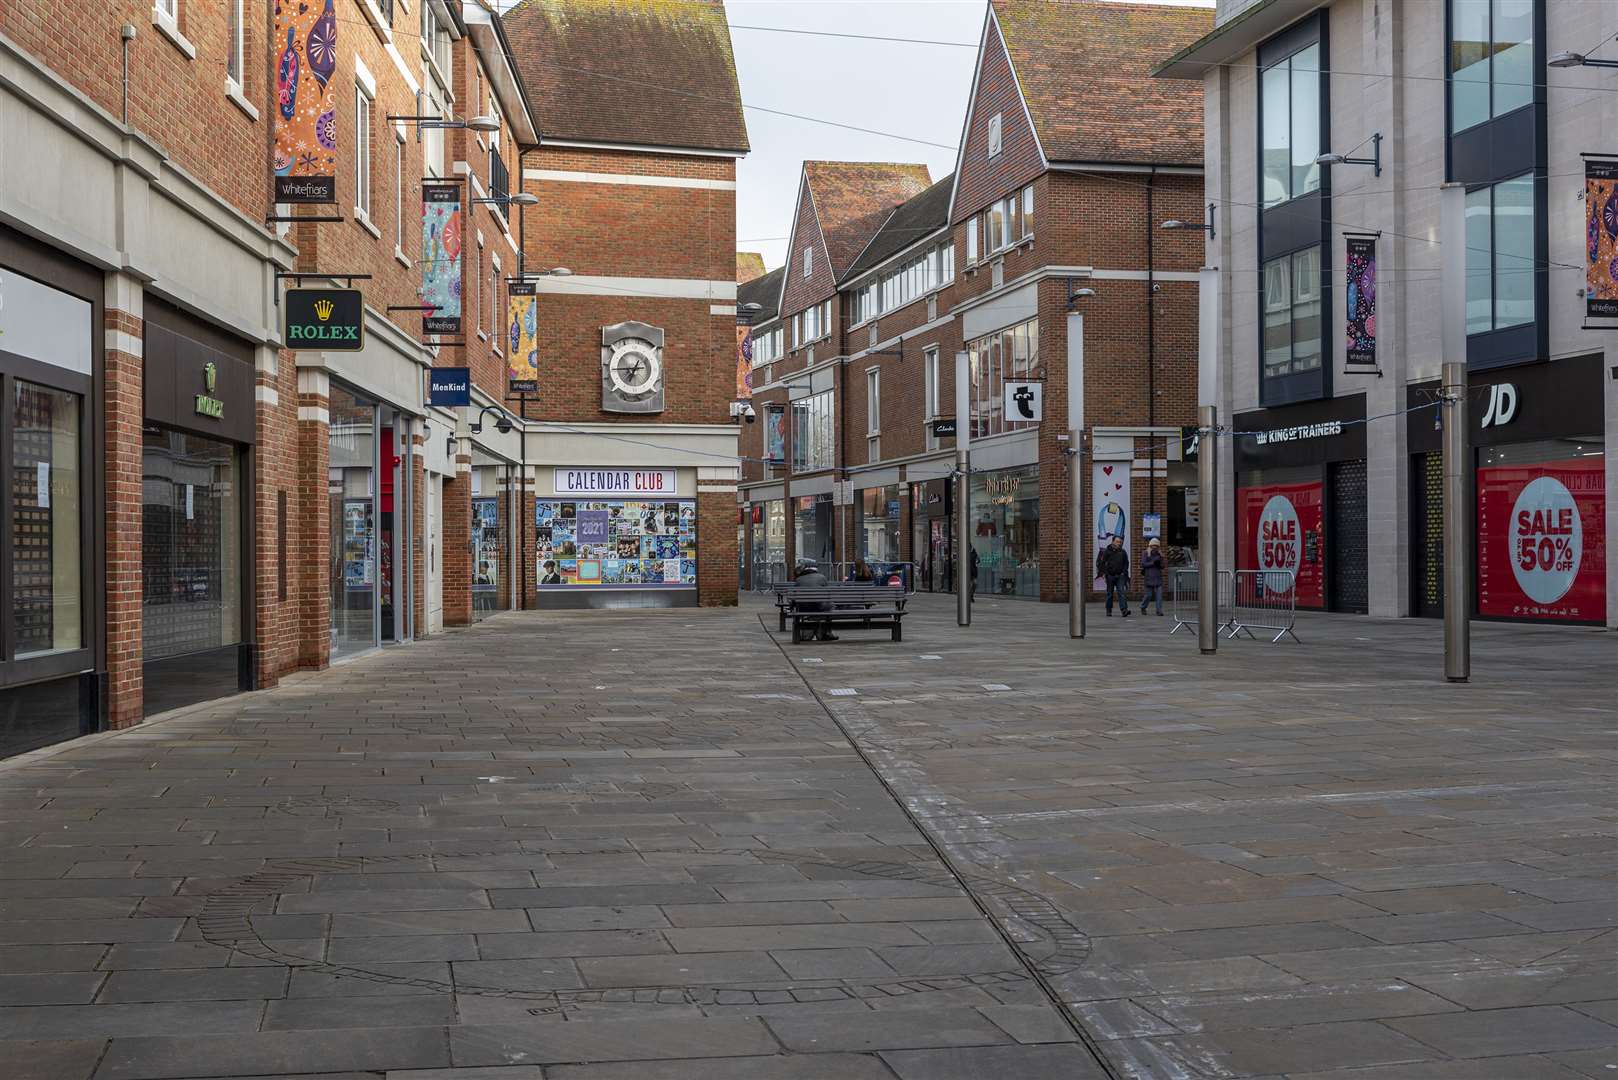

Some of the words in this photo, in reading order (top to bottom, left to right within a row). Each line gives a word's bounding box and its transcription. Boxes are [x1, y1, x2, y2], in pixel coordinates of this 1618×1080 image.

[282, 183, 328, 197] Whitefriars
[289, 325, 358, 339] ROLEX
[1013, 386, 1034, 418] t
[1481, 383, 1517, 428] JD
[1269, 428, 1289, 443] KING
[1289, 427, 1297, 437] OF
[1298, 421, 1341, 439] TRAINERS
[568, 472, 630, 490] CALENDAR
[635, 472, 663, 490] CLUB
[582, 522, 604, 535] 2021
[1263, 520, 1296, 540] SALE
[1518, 509, 1572, 536] SALE
[1264, 542, 1296, 568] 50%
[1520, 537, 1572, 571] 50%
[1285, 561, 1296, 569] OFF
